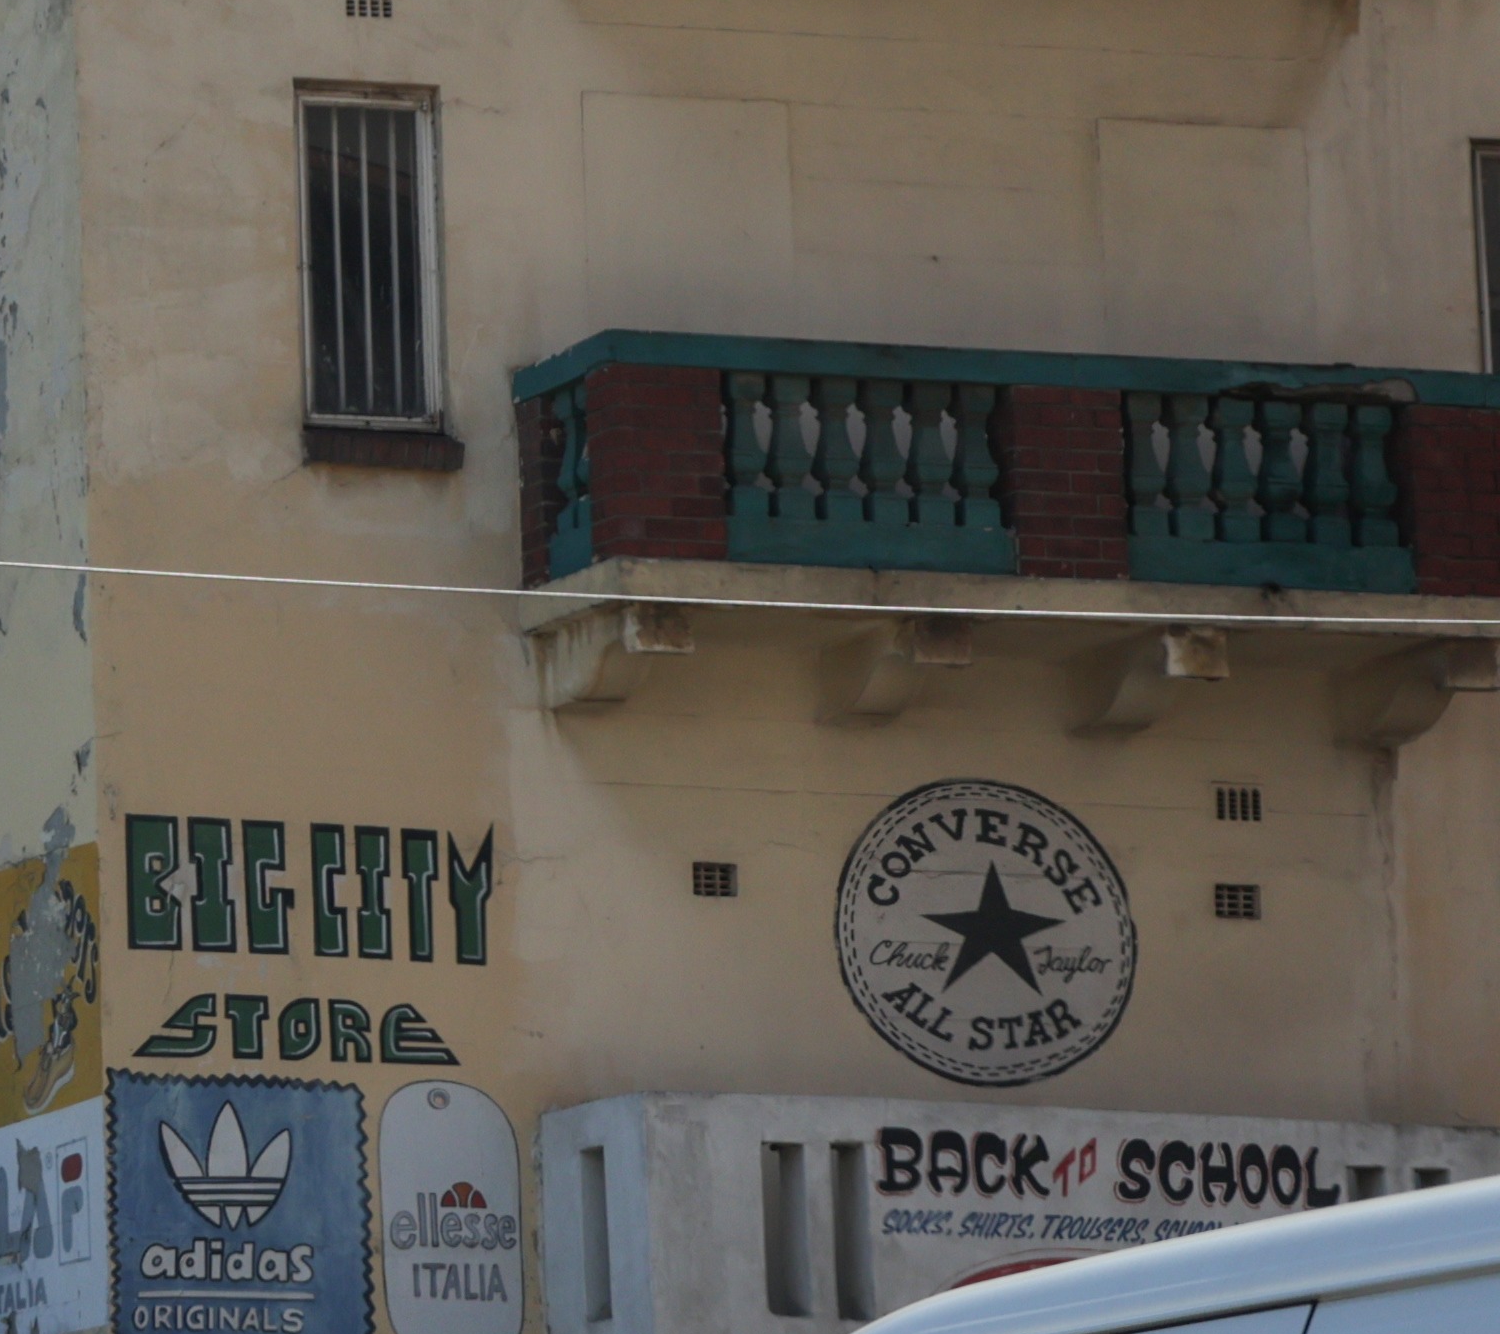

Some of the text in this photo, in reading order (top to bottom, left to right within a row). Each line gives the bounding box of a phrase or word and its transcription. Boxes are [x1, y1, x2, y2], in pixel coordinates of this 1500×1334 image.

[125, 814, 294, 954] BIG
[311, 821, 494, 966] CITY
[866, 807, 1103, 916] CONVERSE
[869, 939, 1113, 984] Chuck Taylor
[132, 993, 461, 1066] STORE
[881, 981, 1083, 1051] ALL STAR
[875, 1126, 1342, 1208] BACK TO SCHOOL
[390, 1190, 517, 1251] ellesse
[881, 1209, 953, 1236] SOCKS,
[958, 1212, 1033, 1240] SHIRTS,
[1039, 1214, 1149, 1244] TROUSERS,
[142, 1240, 314, 1284] adidas
[413, 1263, 508, 1303] ITALIA
[132, 1303, 306, 1334] ORIGINALS
